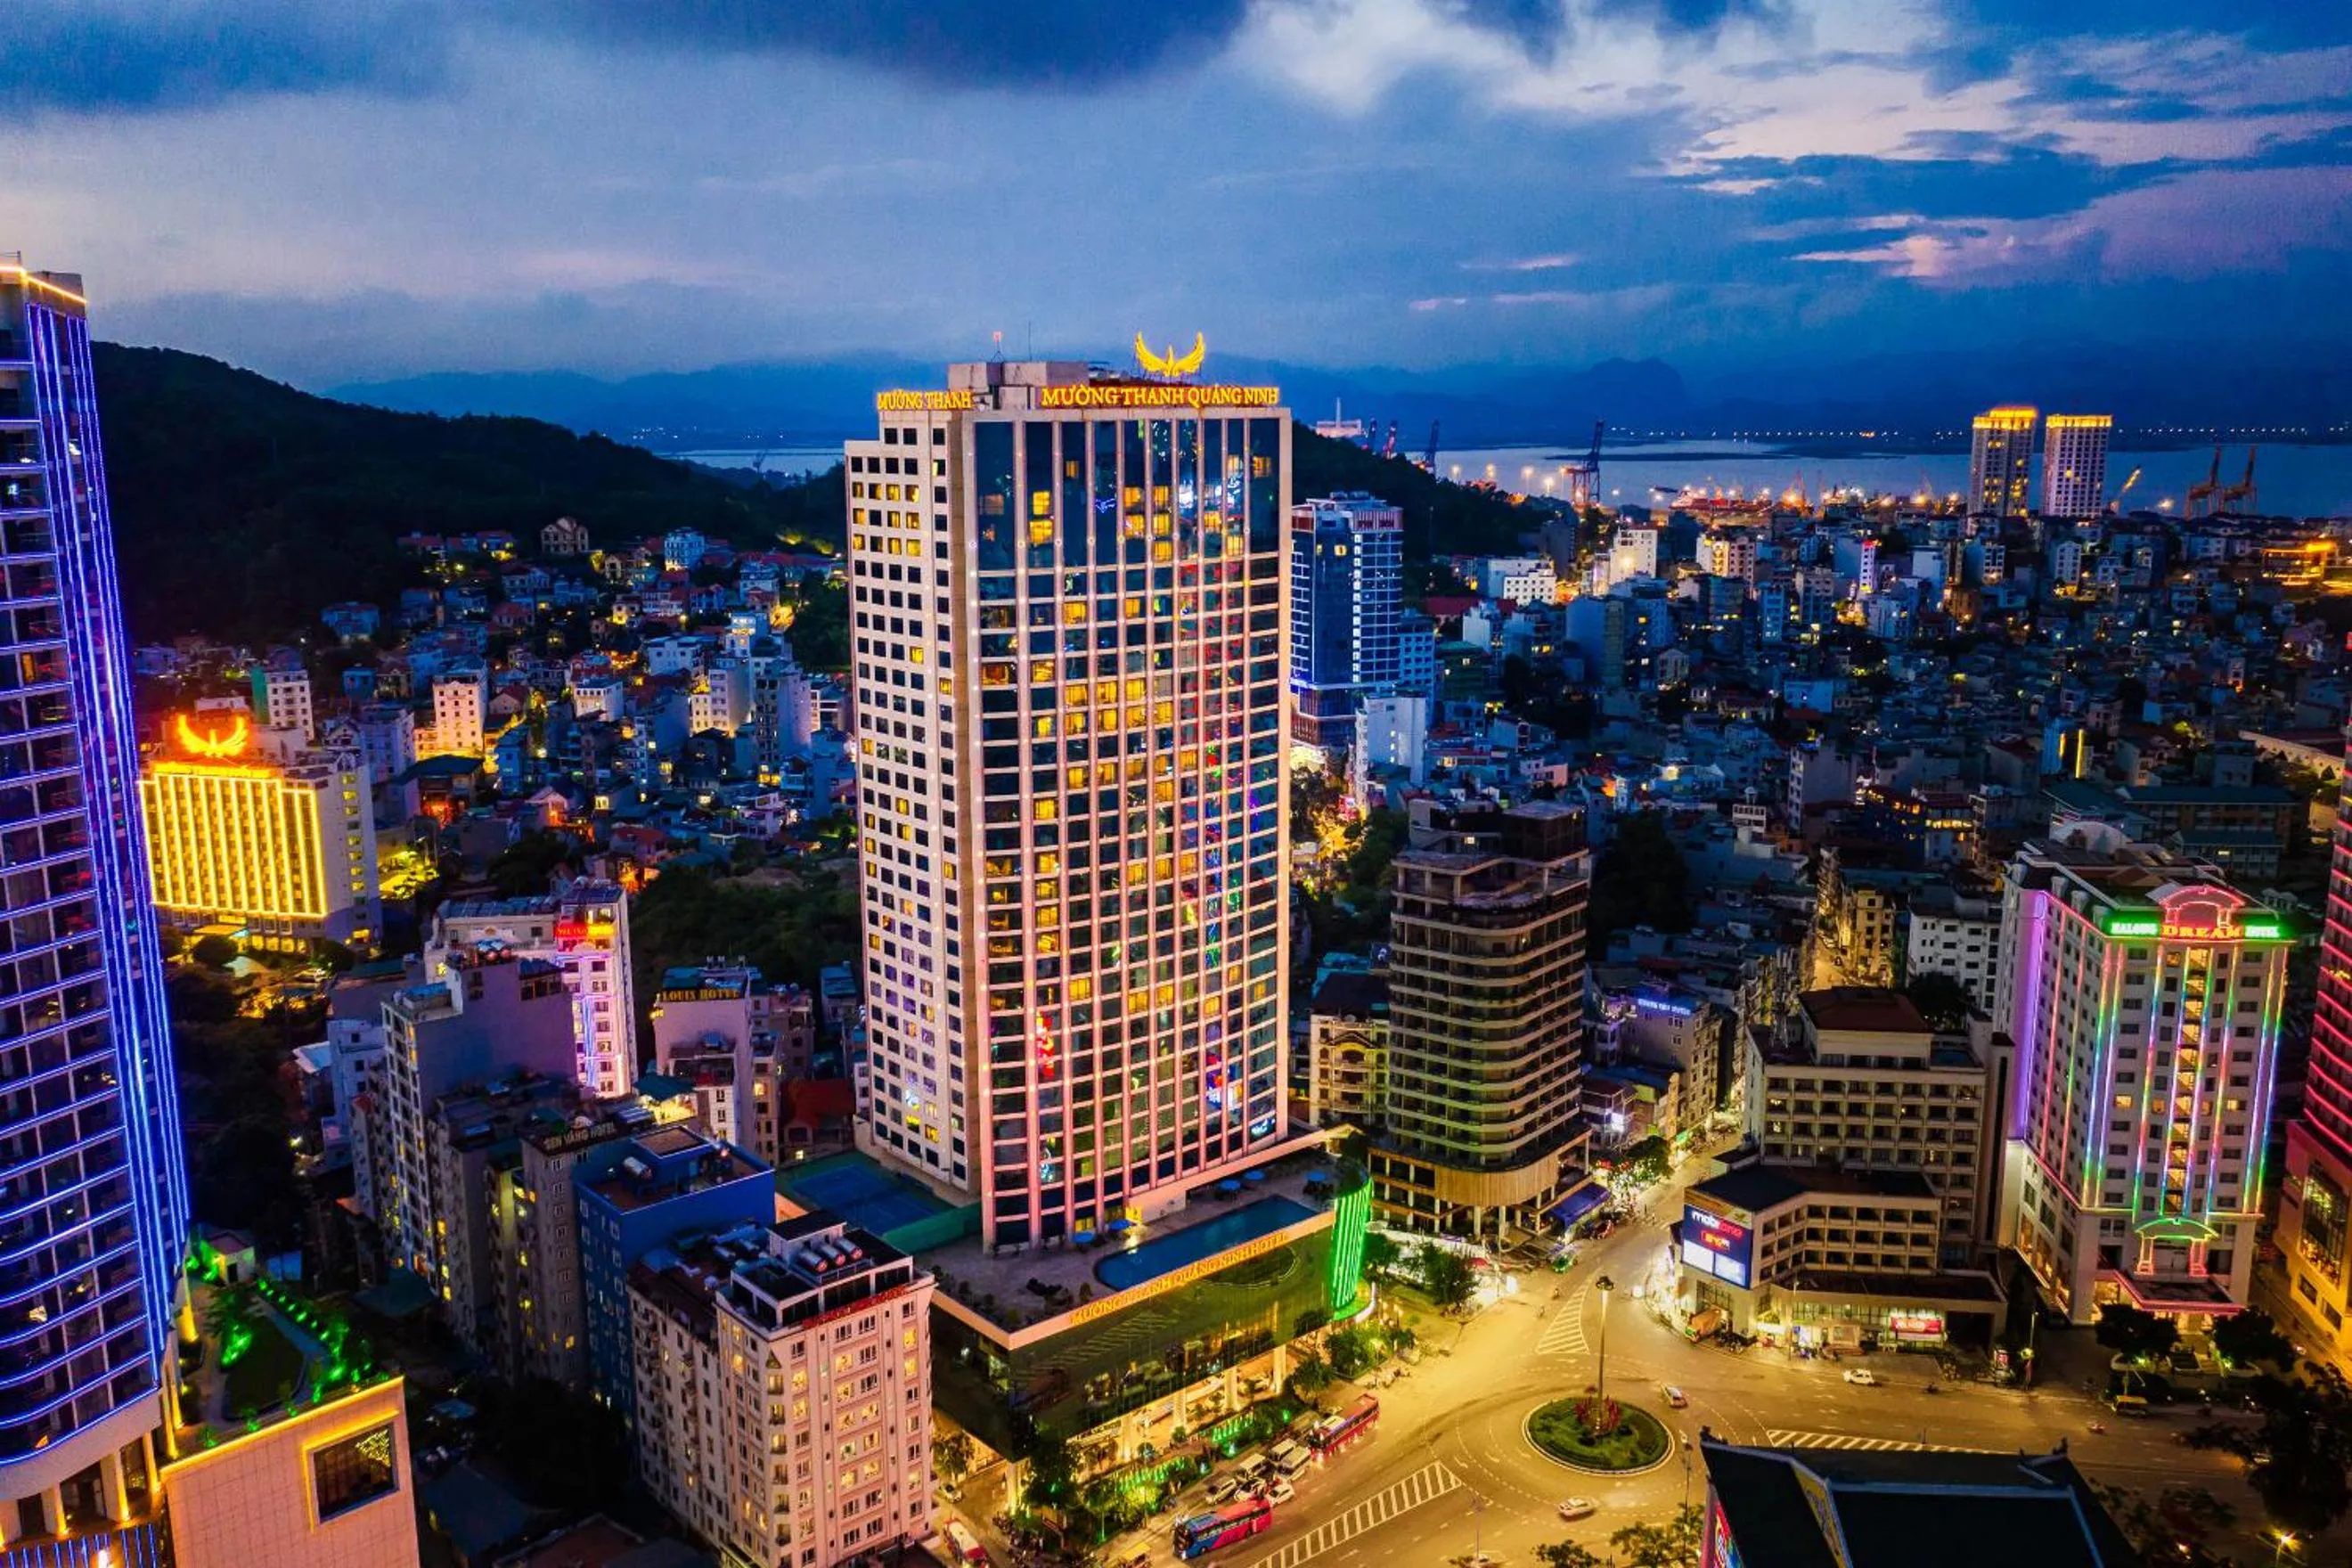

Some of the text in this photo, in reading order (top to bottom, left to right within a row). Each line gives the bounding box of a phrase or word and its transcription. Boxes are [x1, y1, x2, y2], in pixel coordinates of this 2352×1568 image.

[1120, 386, 1184, 405] THANH
[1245, 387, 1279, 404] NINH
[2160, 924, 2242, 938] DREAM
